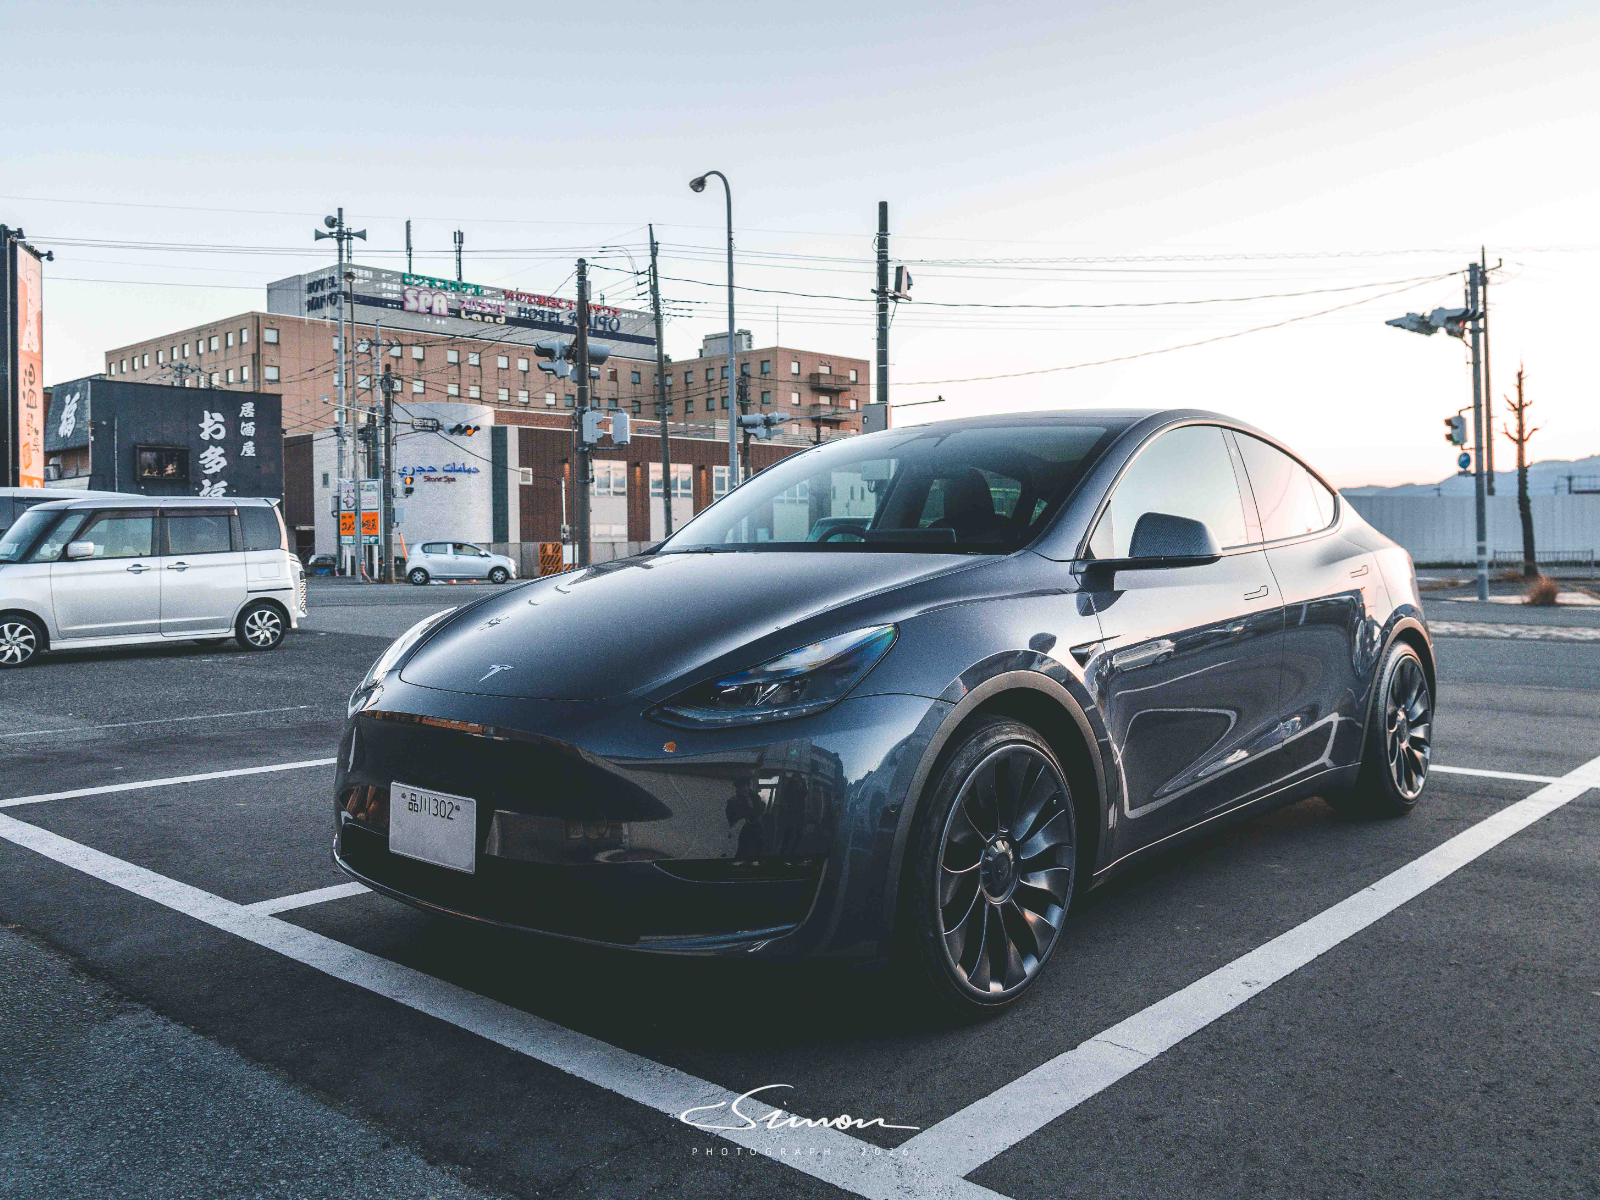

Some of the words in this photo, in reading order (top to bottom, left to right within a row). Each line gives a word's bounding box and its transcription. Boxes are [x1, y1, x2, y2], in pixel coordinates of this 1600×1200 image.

[403, 273, 483, 296] ビジネスホテル
[404, 287, 449, 316] SPA
[517, 306, 564, 325] HOTEL
[239, 402, 256, 457] 居酒屋
[423, 475, 443, 483] Stone
[444, 475, 457, 484] Spa
